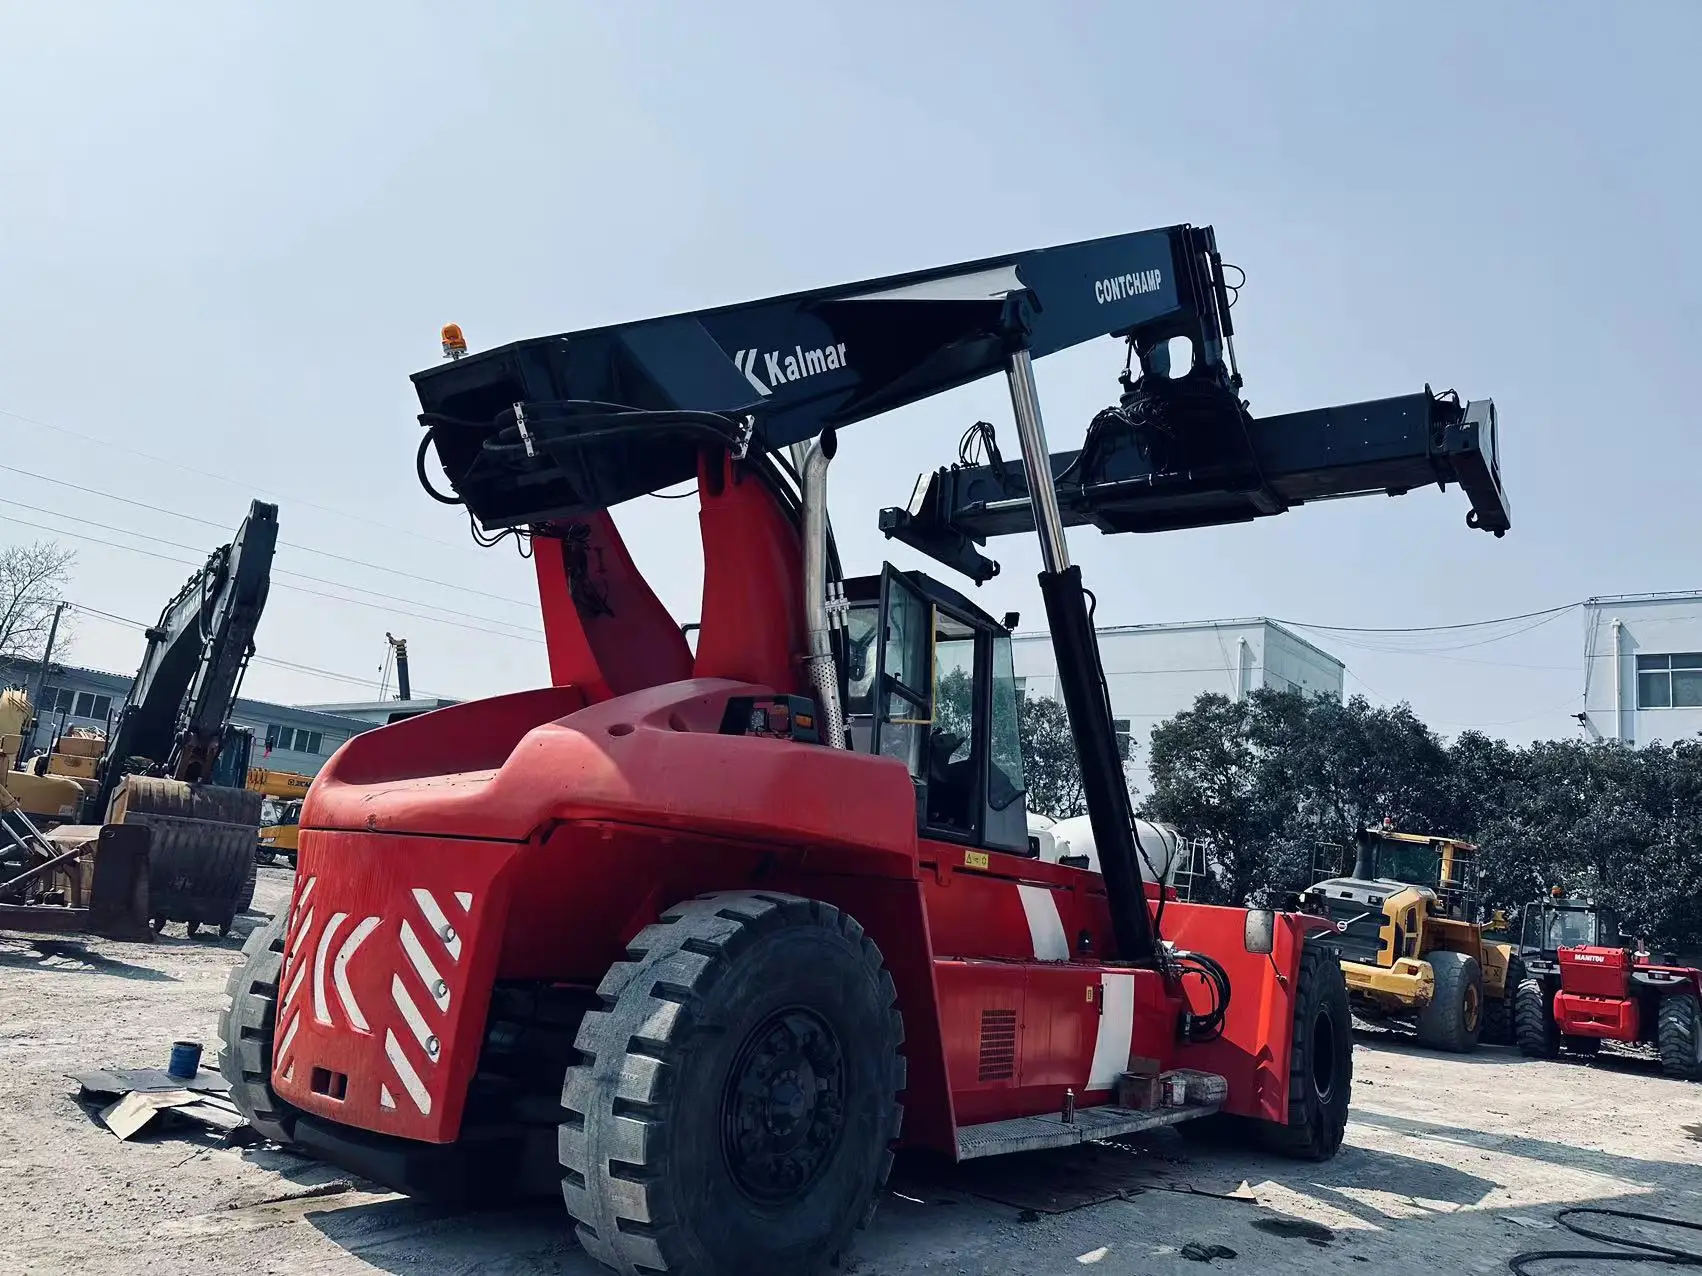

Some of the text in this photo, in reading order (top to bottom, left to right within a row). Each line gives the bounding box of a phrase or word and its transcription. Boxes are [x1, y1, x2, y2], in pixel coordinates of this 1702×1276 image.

[1095, 269, 1162, 304] CONTCHAMP
[764, 342, 847, 386] Kalmar
[1574, 954, 1604, 962] MANITOU
